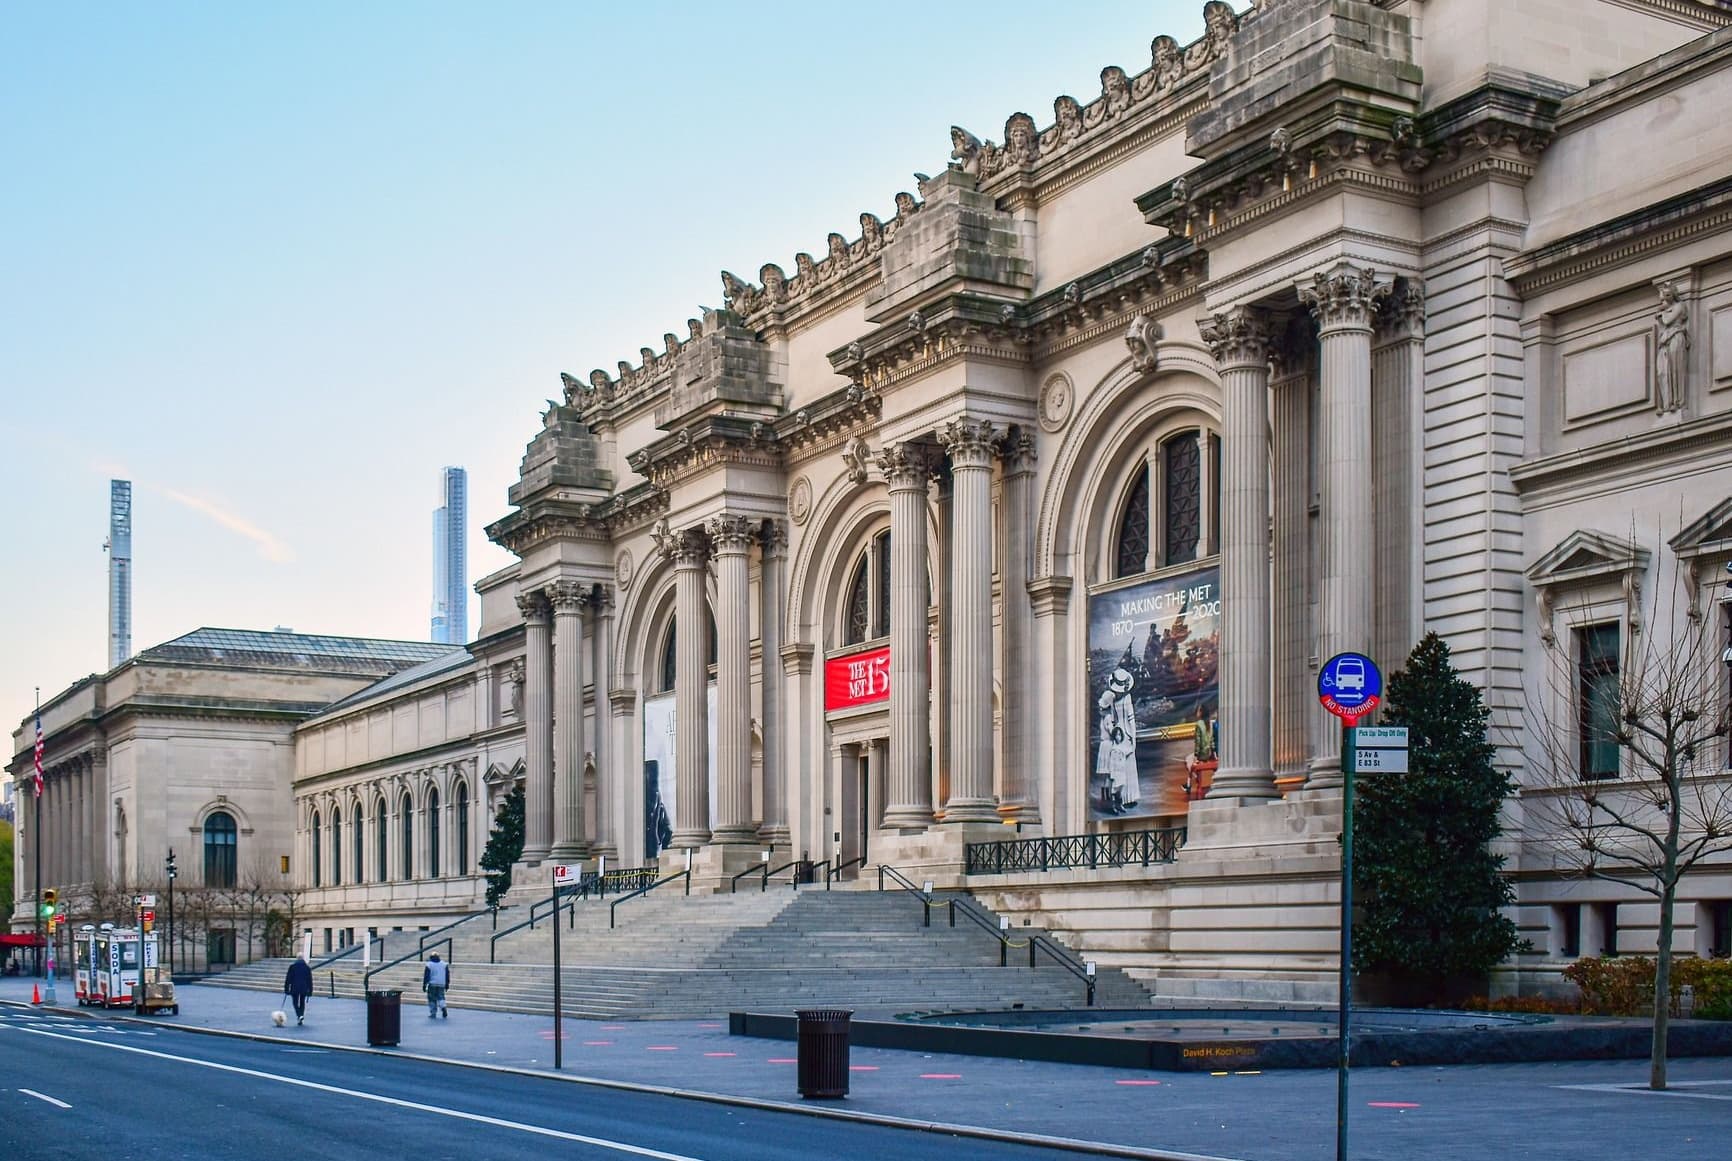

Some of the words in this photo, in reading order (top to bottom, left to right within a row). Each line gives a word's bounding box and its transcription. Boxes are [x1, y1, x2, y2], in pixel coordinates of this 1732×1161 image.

[1121, 595, 1162, 617] MAKING
[1165, 590, 1186, 606] THE
[1188, 584, 1212, 602] MET
[1111, 621, 1133, 637] 1870
[848, 661, 866, 680] THE
[866, 656, 890, 695] 15
[849, 679, 867, 699] MET
[1326, 698, 1336, 710] NO
[1337, 699, 1374, 715] STANDING
[1183, 1048, 1204, 1058] David
[1215, 1048, 1234, 1056] Koch
